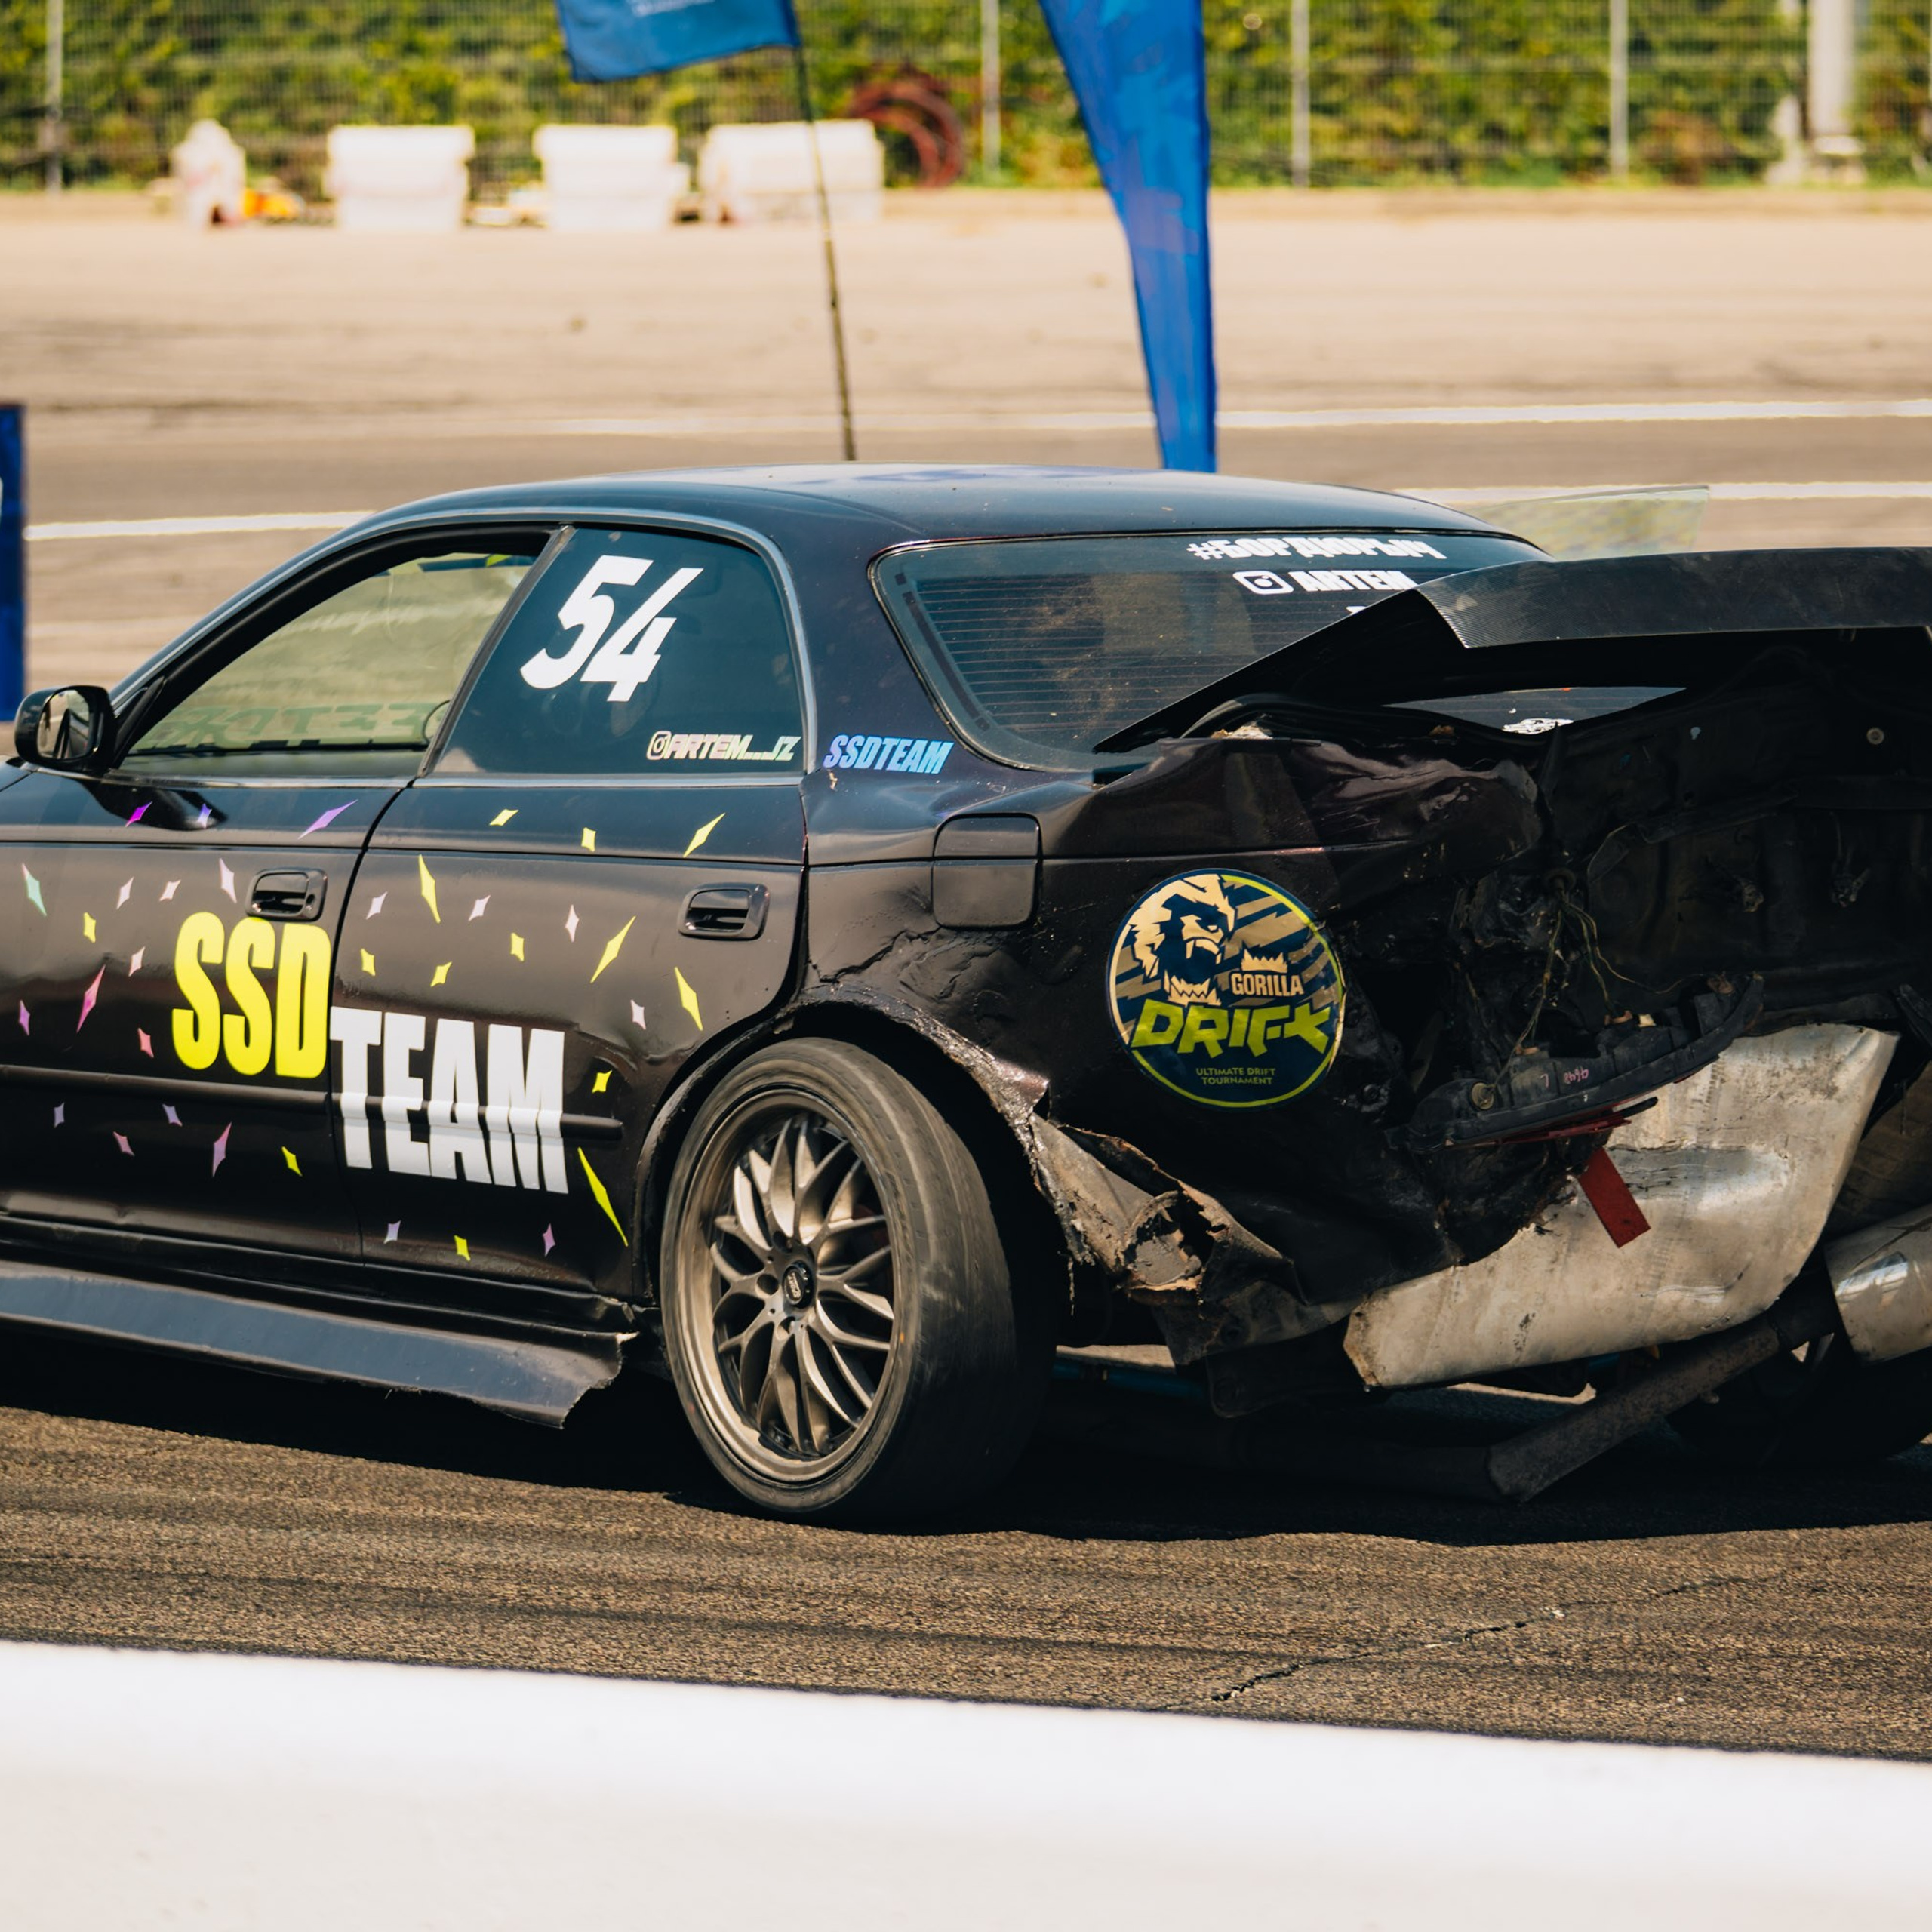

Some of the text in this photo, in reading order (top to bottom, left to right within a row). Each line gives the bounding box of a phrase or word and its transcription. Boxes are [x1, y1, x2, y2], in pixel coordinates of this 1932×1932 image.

[520, 555, 704, 702] 54
[823, 734, 955, 774] SSDTEAM
[172, 912, 331, 1078] SSD
[1231, 973, 1304, 997] GORILLA
[1196, 1067, 1275, 1075] ULTIMATE DRIFT
[1201, 1077, 1272, 1085] TOURNAMENT
[330, 1006, 568, 1194] TEAM
